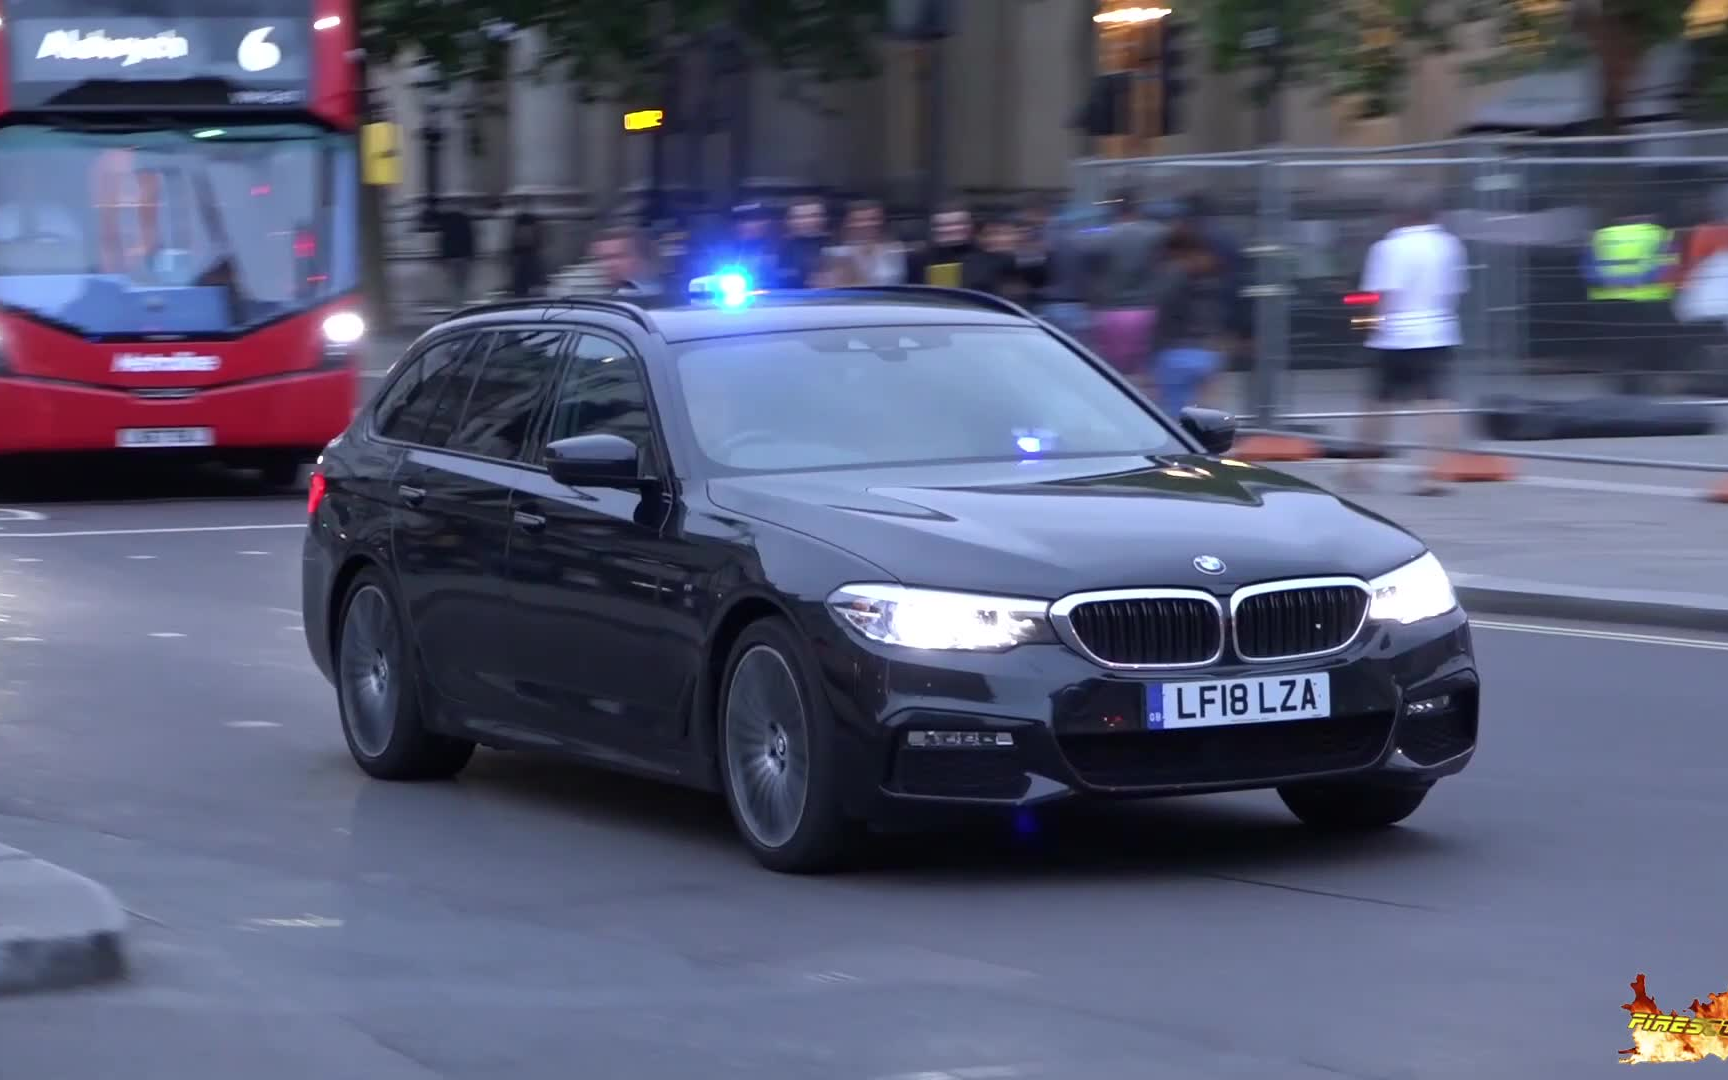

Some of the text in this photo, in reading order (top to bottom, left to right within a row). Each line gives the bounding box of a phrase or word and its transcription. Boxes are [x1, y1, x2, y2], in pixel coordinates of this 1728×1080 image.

[237, 26, 281, 72] 6
[1177, 678, 1317, 719] LF18 LZA
